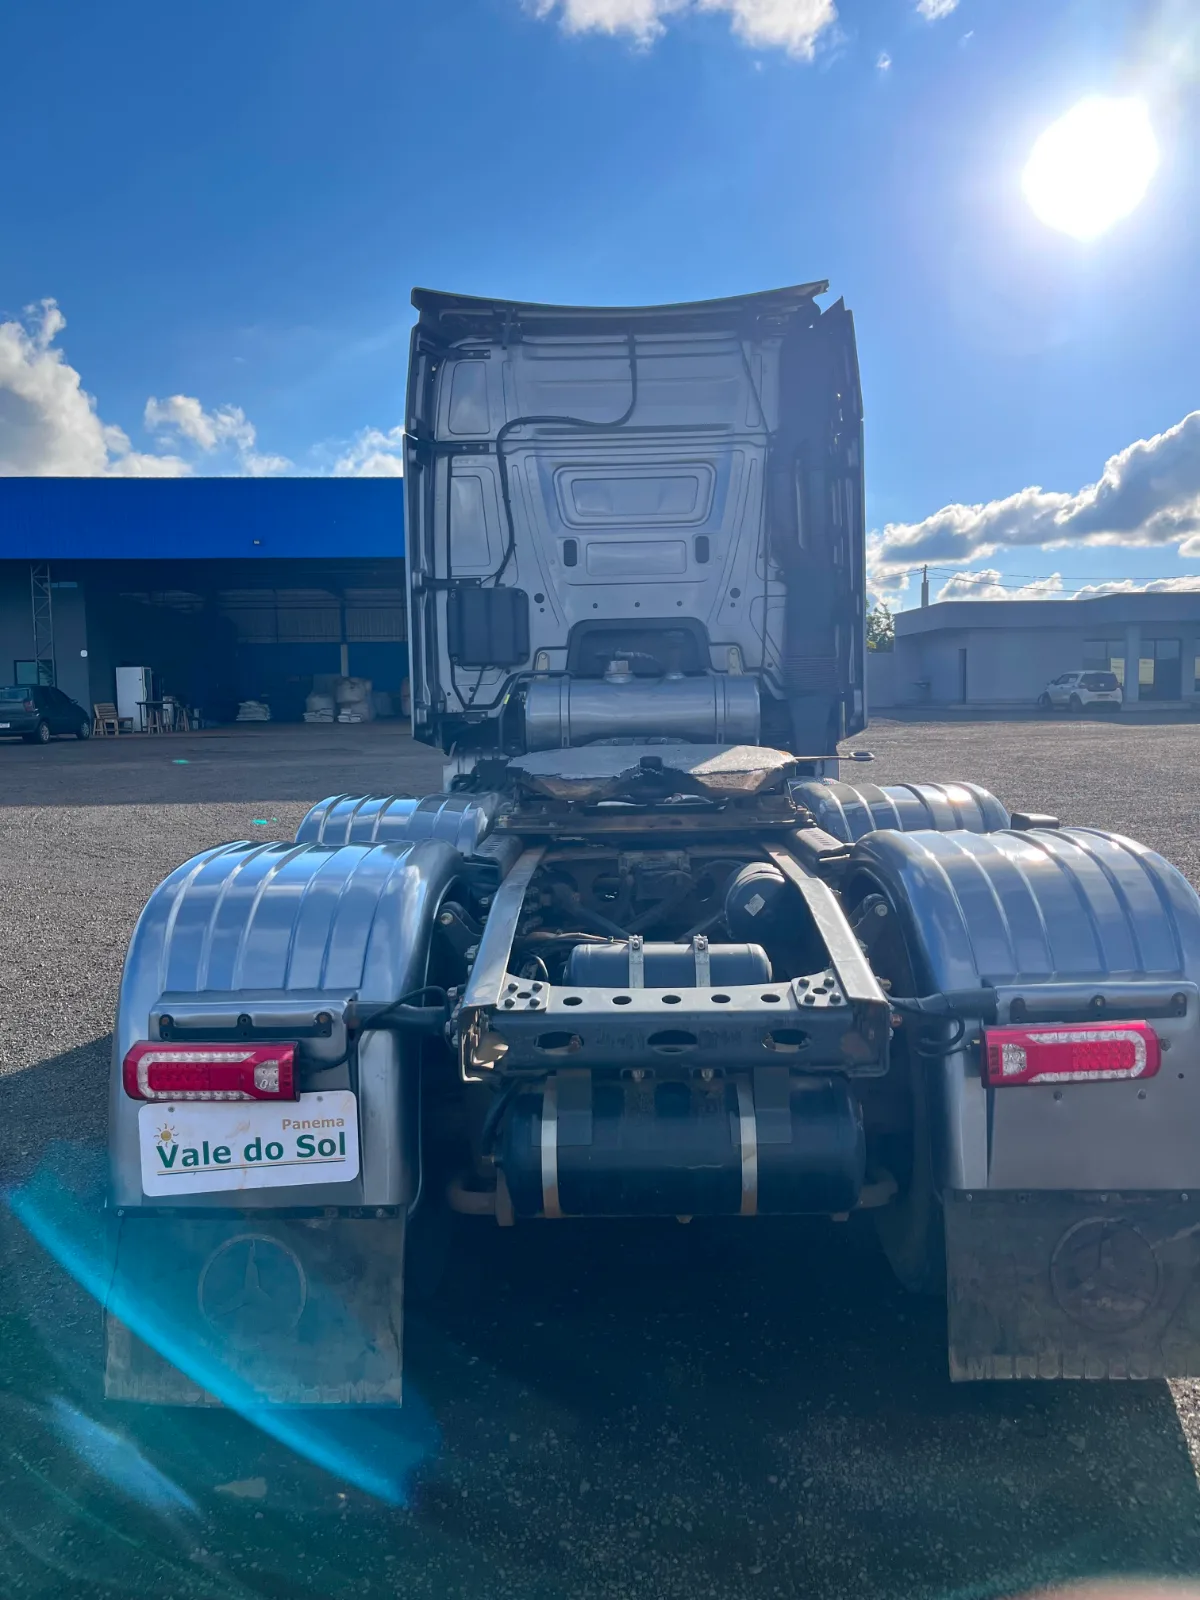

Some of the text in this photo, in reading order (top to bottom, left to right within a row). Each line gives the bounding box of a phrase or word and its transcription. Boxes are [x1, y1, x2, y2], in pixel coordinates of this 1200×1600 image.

[281, 1117, 345, 1131] Panema
[155, 1131, 346, 1169] Vale do Sol
